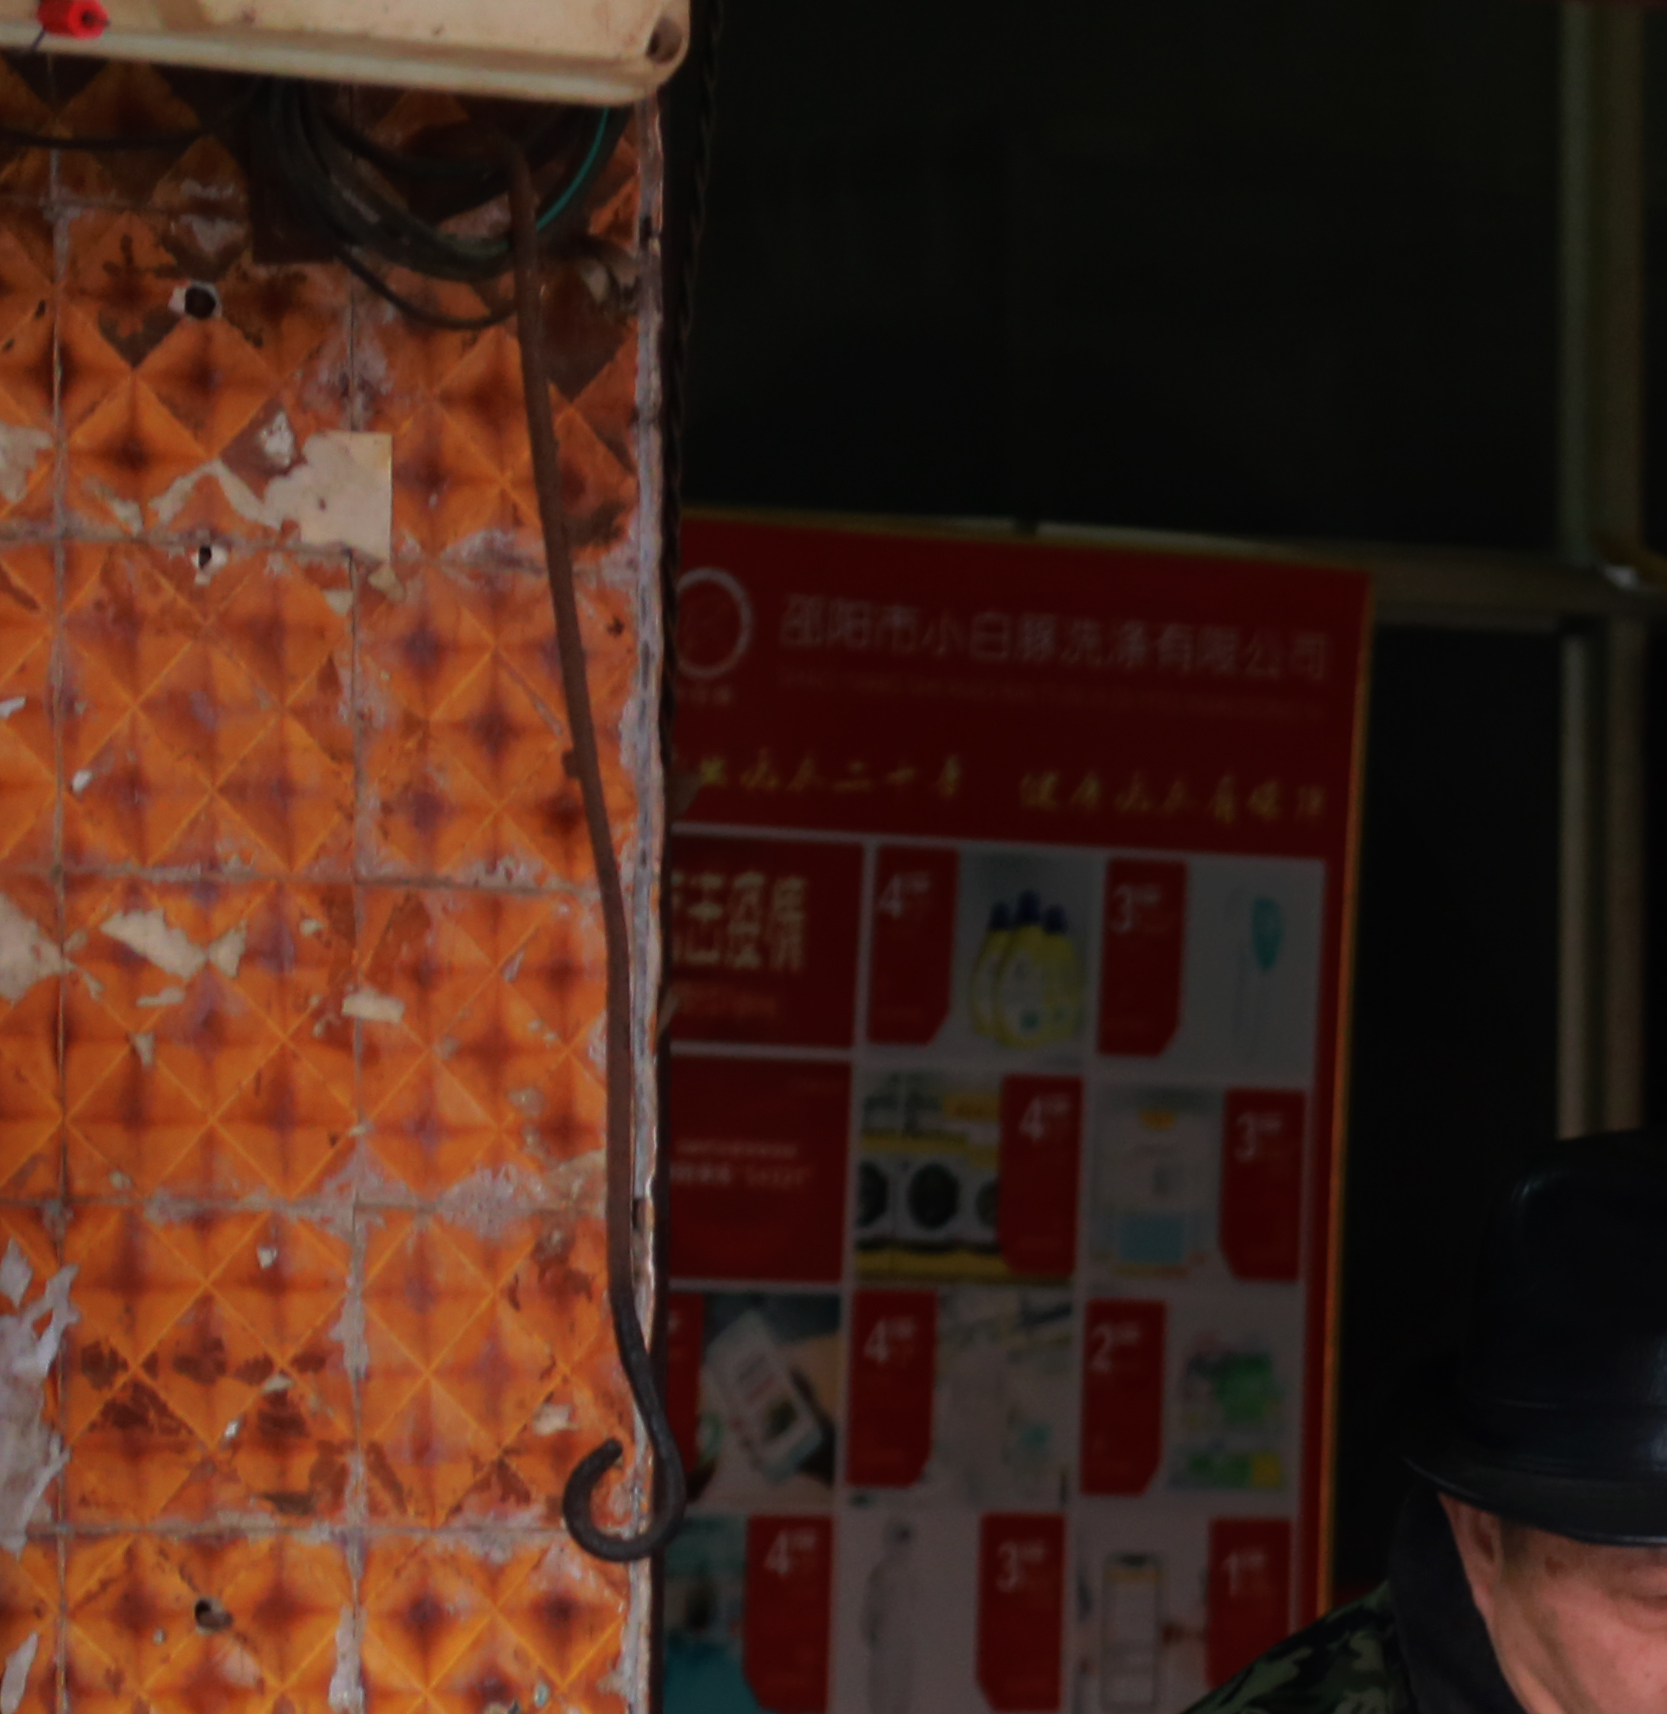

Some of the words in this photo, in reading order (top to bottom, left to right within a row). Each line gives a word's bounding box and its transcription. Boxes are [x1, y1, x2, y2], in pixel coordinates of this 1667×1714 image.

[778, 592, 1334, 684] 邵阳市小白豚洗涤有限公司
